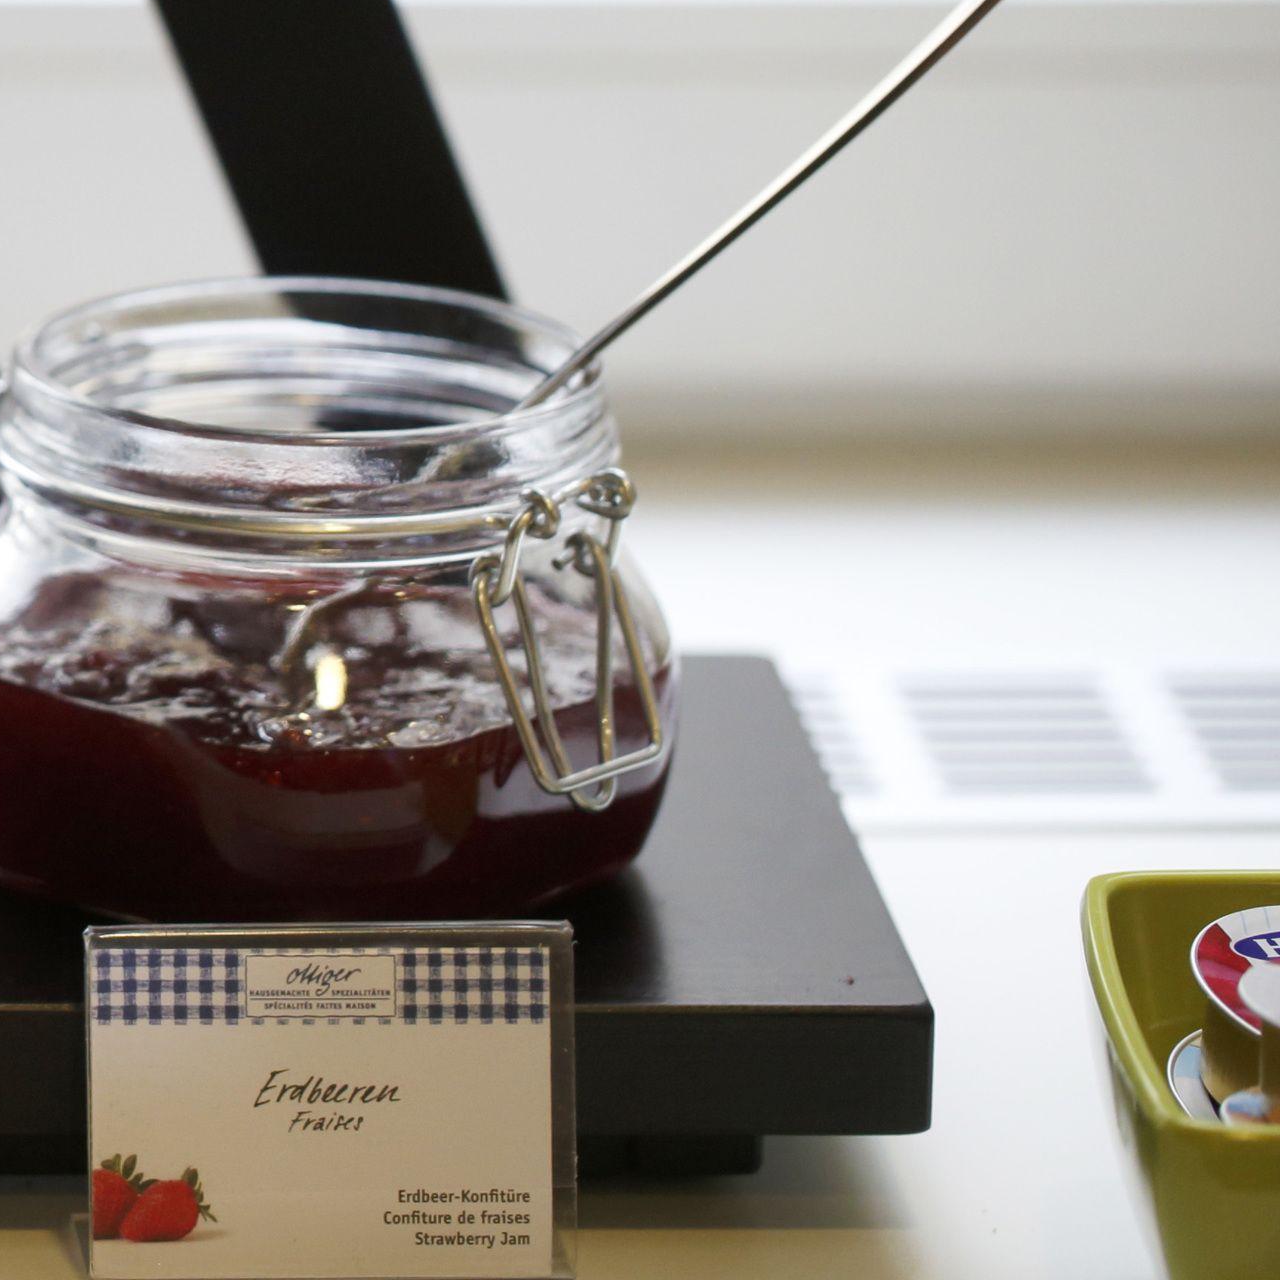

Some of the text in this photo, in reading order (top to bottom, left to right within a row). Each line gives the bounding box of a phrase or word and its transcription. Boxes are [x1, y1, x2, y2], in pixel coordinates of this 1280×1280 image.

[249, 987, 391, 998] HAUSGEMACHTE SPEZIALITÄTEN
[254, 1070, 400, 1107] Erdbeeren
[289, 1111, 363, 1131] Fraises
[399, 1189, 530, 1203] Erdbeer-Konfitüre
[384, 1210, 530, 1224] Confiture de fraises
[415, 1232, 530, 1249] Strawberry Jam
